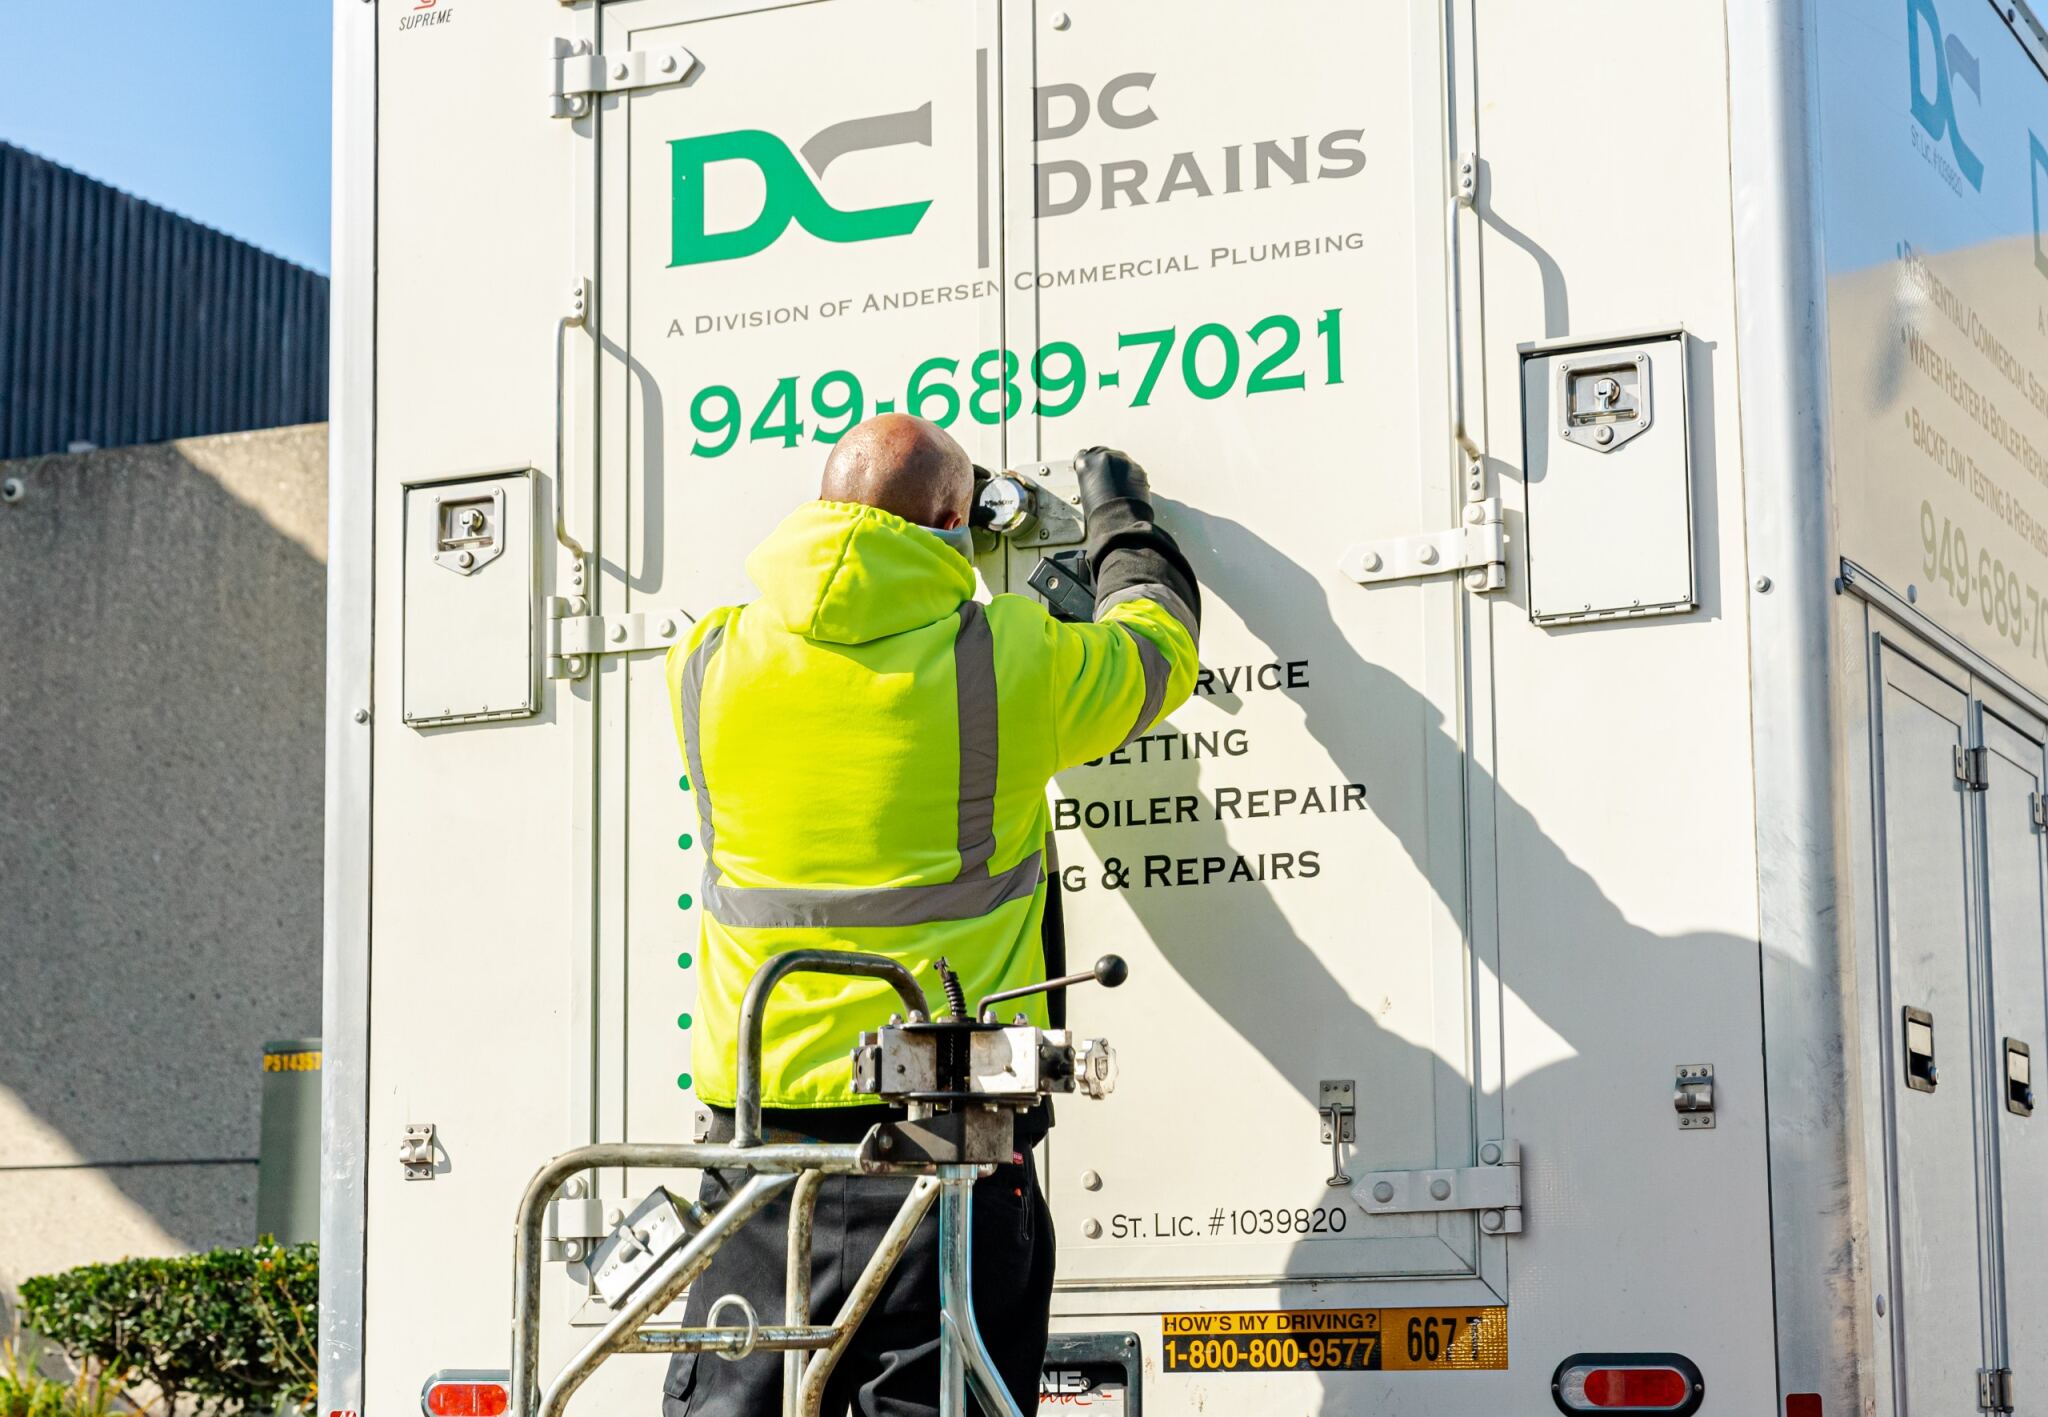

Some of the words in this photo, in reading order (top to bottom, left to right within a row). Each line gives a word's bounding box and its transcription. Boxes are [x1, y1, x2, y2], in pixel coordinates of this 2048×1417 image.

[399, 8, 453, 31] SUPREME
[1031, 72, 1159, 142] DC
[665, 100, 934, 269] DC
[1031, 129, 1367, 219] DRAINS
[666, 318, 685, 338] A
[695, 304, 810, 335] DIVISION
[819, 299, 854, 319] OF
[863, 280, 1000, 313] ANDERSEN
[1014, 253, 1199, 291] COMMERCIAL
[1211, 232, 1365, 268] PLUMBING
[690, 308, 1343, 459] 949-689-7021
[1912, 406, 1966, 486] BACKFLOW
[1967, 454, 2004, 520] TESTING
[1193, 660, 1310, 697] RVICE
[1054, 795, 1200, 831] BOILER
[1214, 784, 1368, 821] REPAIR
[1101, 856, 1130, 890] &
[1144, 851, 1321, 888] REPAIRS
[1112, 1214, 1147, 1239] ST.
[1155, 1212, 1201, 1238] LIC.
[1208, 1207, 1347, 1236] #1039820
[1164, 1316, 1232, 1332] HOW'S
[1239, 1315, 1270, 1331] MY
[1277, 1313, 1377, 1330] DRIVING?
[1165, 1338, 1376, 1369] 1-800-800-9577
